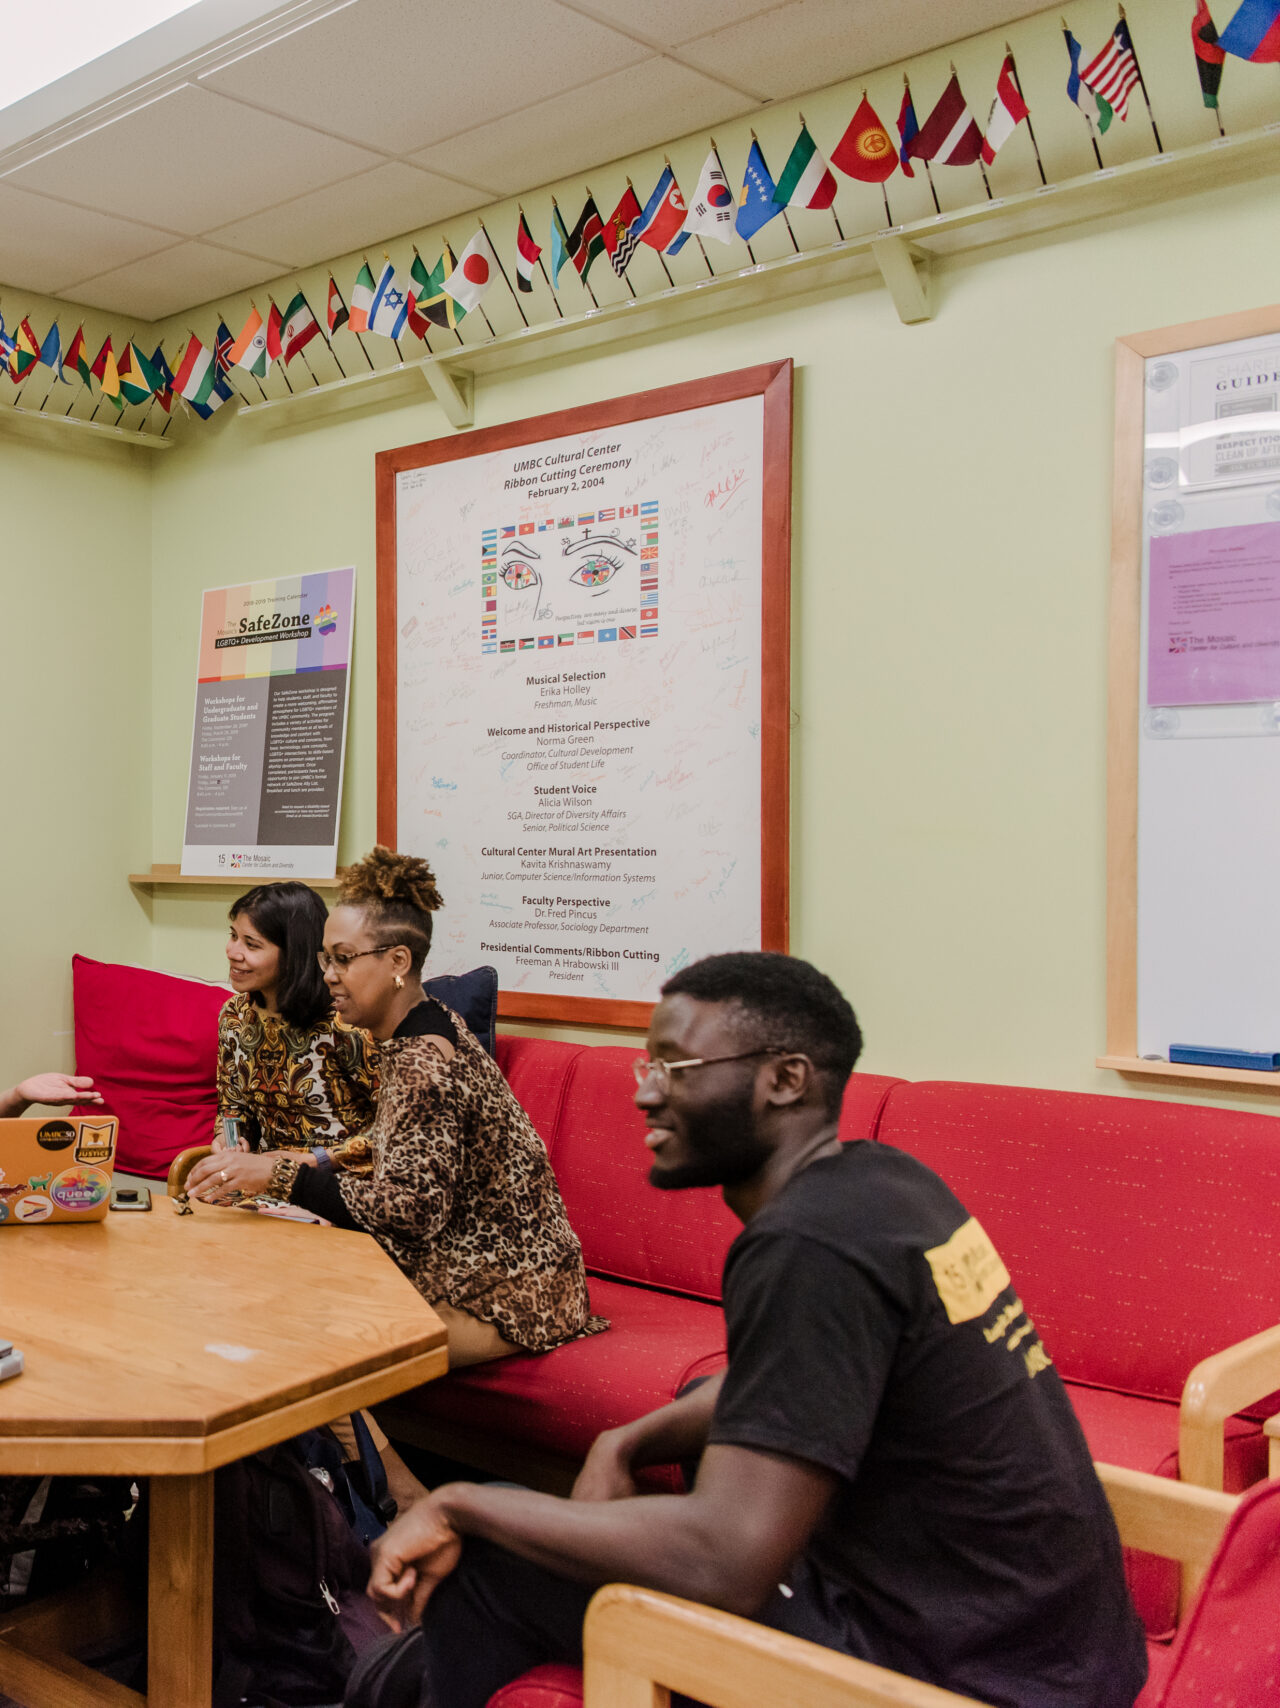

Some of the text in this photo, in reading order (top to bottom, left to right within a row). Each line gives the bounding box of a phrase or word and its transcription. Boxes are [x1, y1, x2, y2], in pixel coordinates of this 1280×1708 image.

[1216, 438, 1256, 450] RESPECT
[513, 444, 621, 472] UMBC Cultural Center
[504, 458, 631, 489] Ribbon Cutting Ceremony
[528, 477, 604, 498] February 2, 2004
[239, 613, 310, 634] SafeZone
[217, 630, 309, 647] LGBTQ+ Development Workshop
[526, 671, 605, 684] Musical Selection
[540, 685, 590, 696] Erika Holley
[205, 697, 235, 705] Workshops
[574, 697, 597, 705] Music
[204, 705, 245, 714] Undergraduate
[487, 719, 650, 736] Welcome and Historical Perspective
[536, 734, 594, 745] Norma Green
[501, 746, 633, 760] Coordinator, Cultural Development
[200, 755, 231, 763] Workshops
[526, 758, 604, 770] Office of Student Life
[226, 763, 248, 772] Faculty
[534, 784, 596, 794] Student Voice
[538, 797, 592, 806] Alicia Wilson
[522, 822, 609, 832] Senior, Political Science
[481, 847, 656, 856] Cultural Center Mural Art Presentation
[218, 854, 225, 863] 15
[521, 860, 611, 870] Kavita Krishnaswamy
[522, 896, 610, 907] Faculty Perspective
[534, 908, 596, 919] Dr. Fred Pincus
[480, 942, 659, 962] Presidential Comments/Ribbon Cutting
[516, 956, 552, 966] Freeman
[554, 958, 560, 966] A
[562, 959, 608, 969] Hrabowski
[548, 970, 584, 980] President
[57, 1190, 96, 1201] queer
